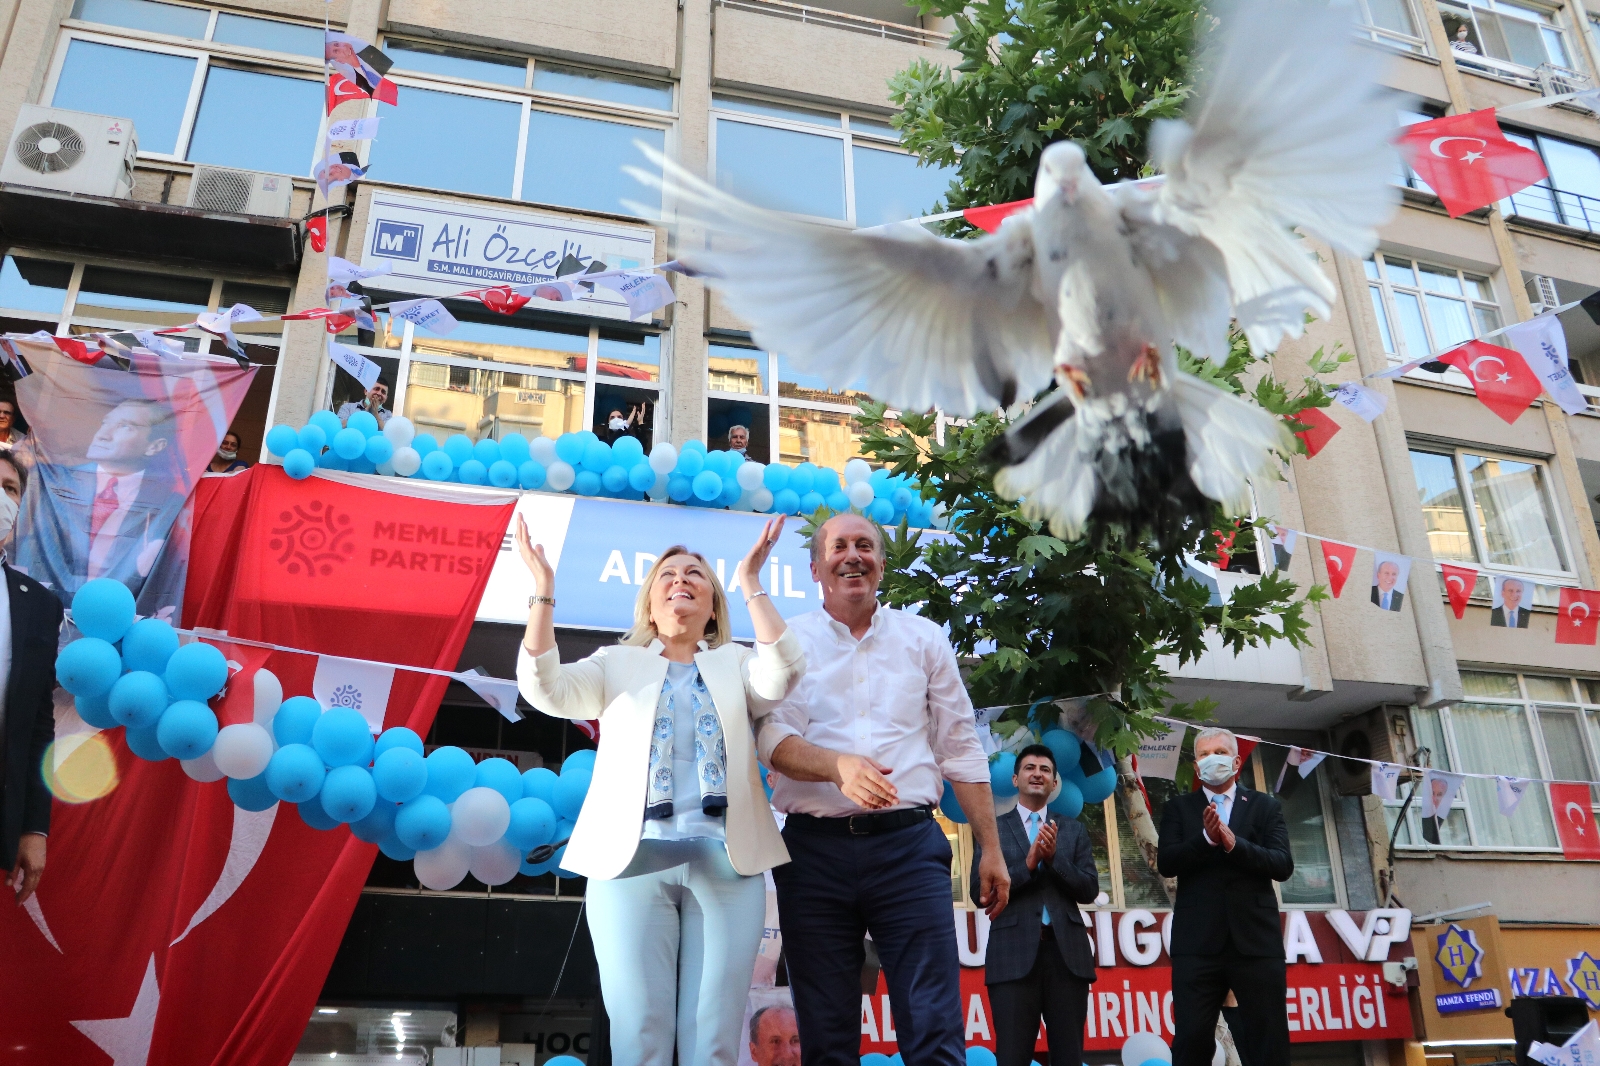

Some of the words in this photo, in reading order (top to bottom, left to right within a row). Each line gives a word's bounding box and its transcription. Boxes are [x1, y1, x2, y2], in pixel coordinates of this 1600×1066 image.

[432, 223, 471, 259] Ali
[433, 263, 451, 273] S.M.
[453, 266, 473, 276] MALİ
[373, 520, 531, 551] MEMLEKE
[598, 549, 744, 594] ADA
[771, 556, 805, 599] İL
[1436, 995, 1464, 1007] HAMZA
